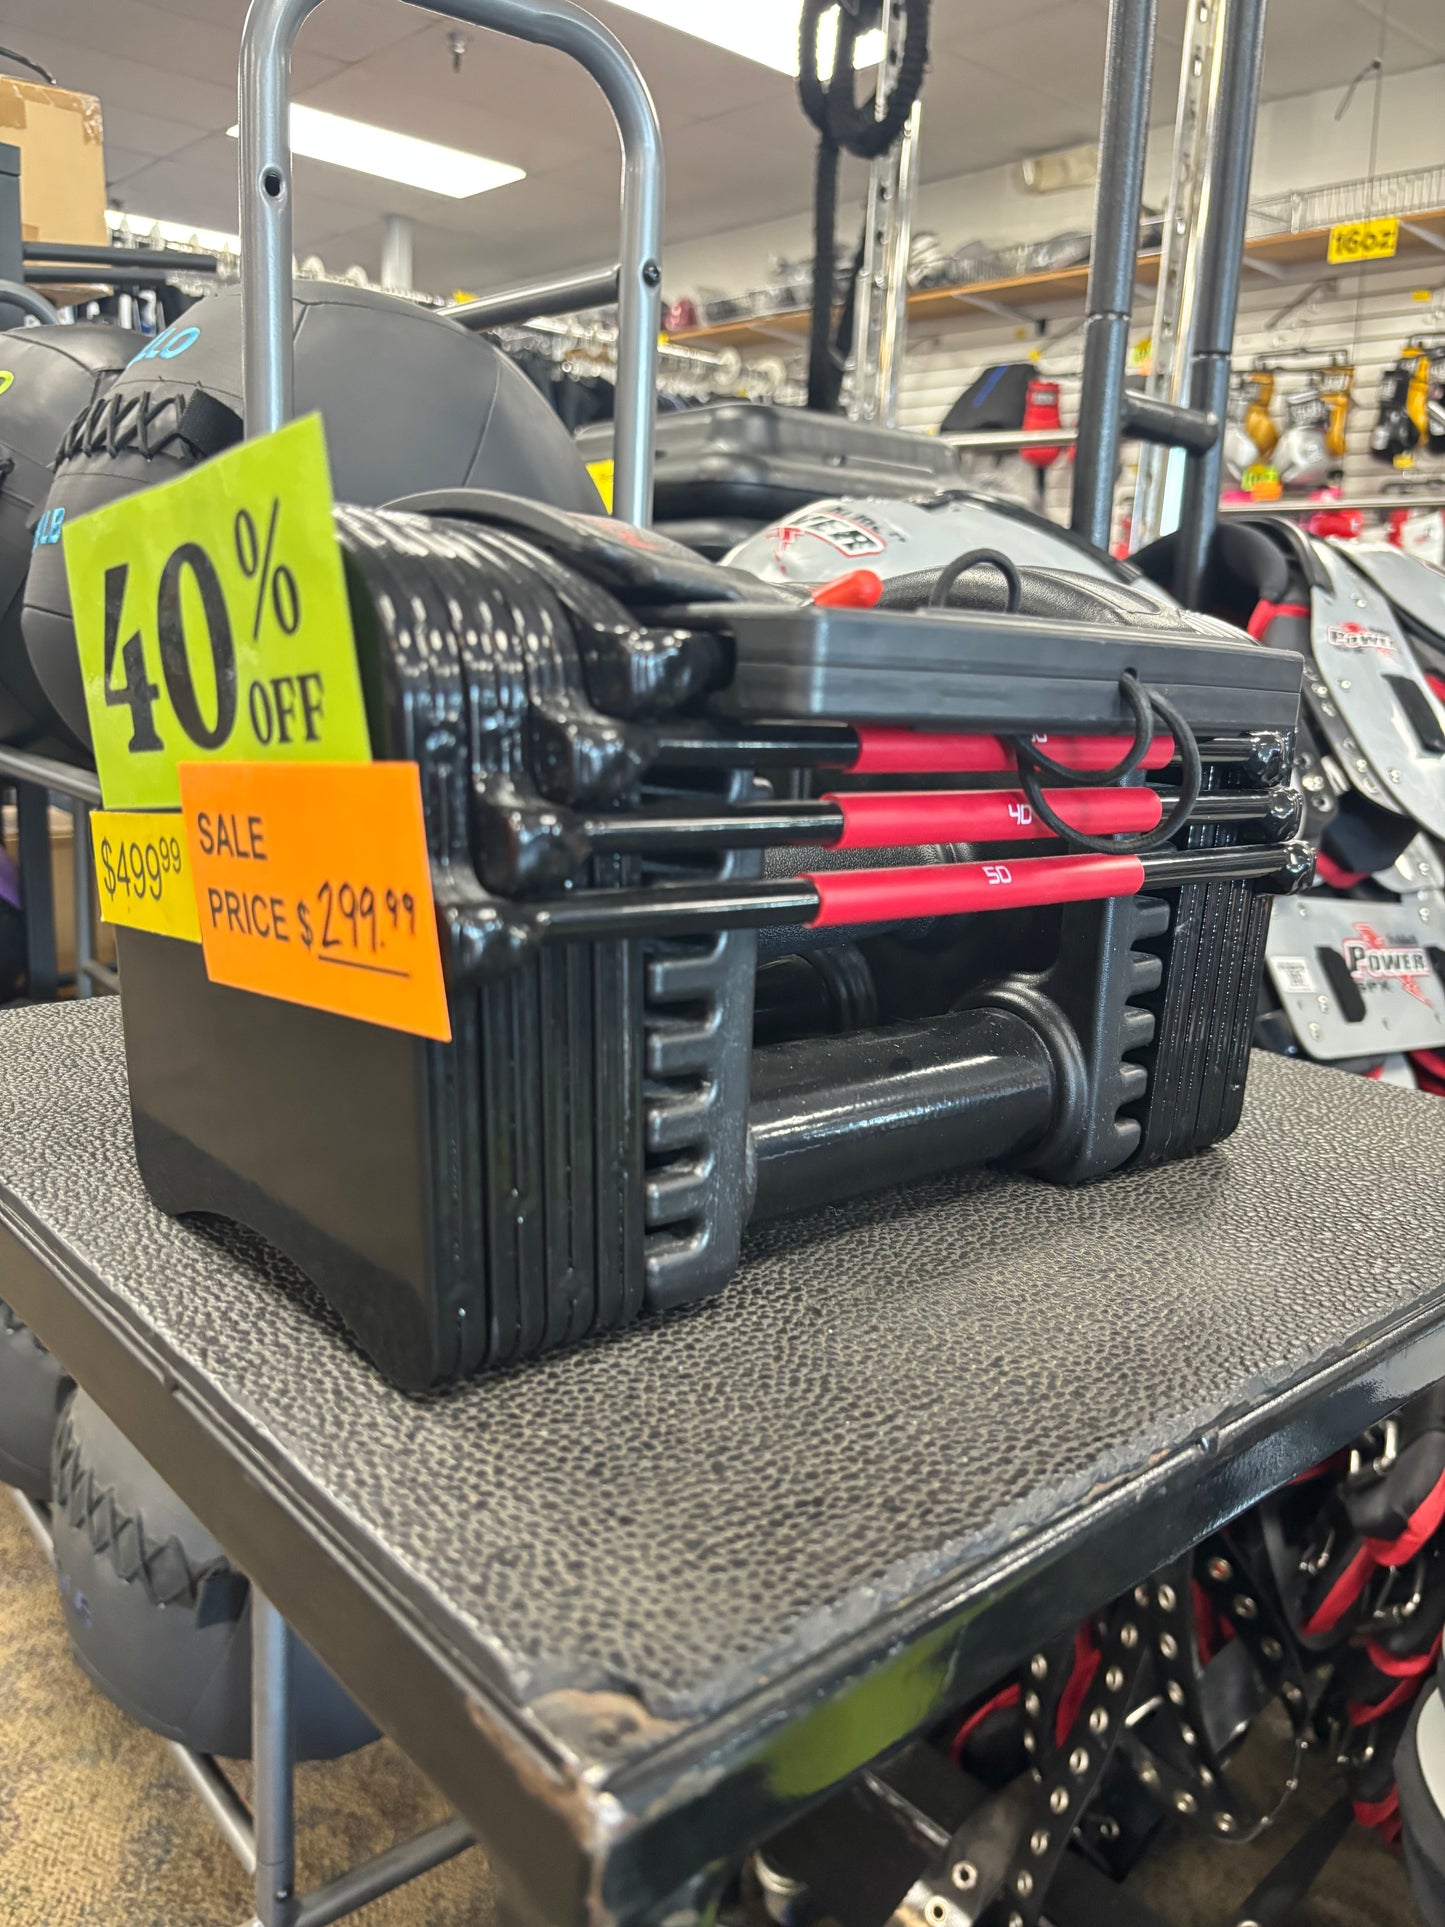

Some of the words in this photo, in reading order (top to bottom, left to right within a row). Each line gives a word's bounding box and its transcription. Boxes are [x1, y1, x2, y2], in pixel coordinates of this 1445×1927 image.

[32, 508, 65, 552] LB
[249, 673, 324, 746] OFF
[198, 812, 268, 861] SALE
[1008, 804, 1032, 825] 40
[982, 866, 1012, 884] 50
[207, 887, 290, 942] PRICE
[1347, 945, 1425, 971] POWER
